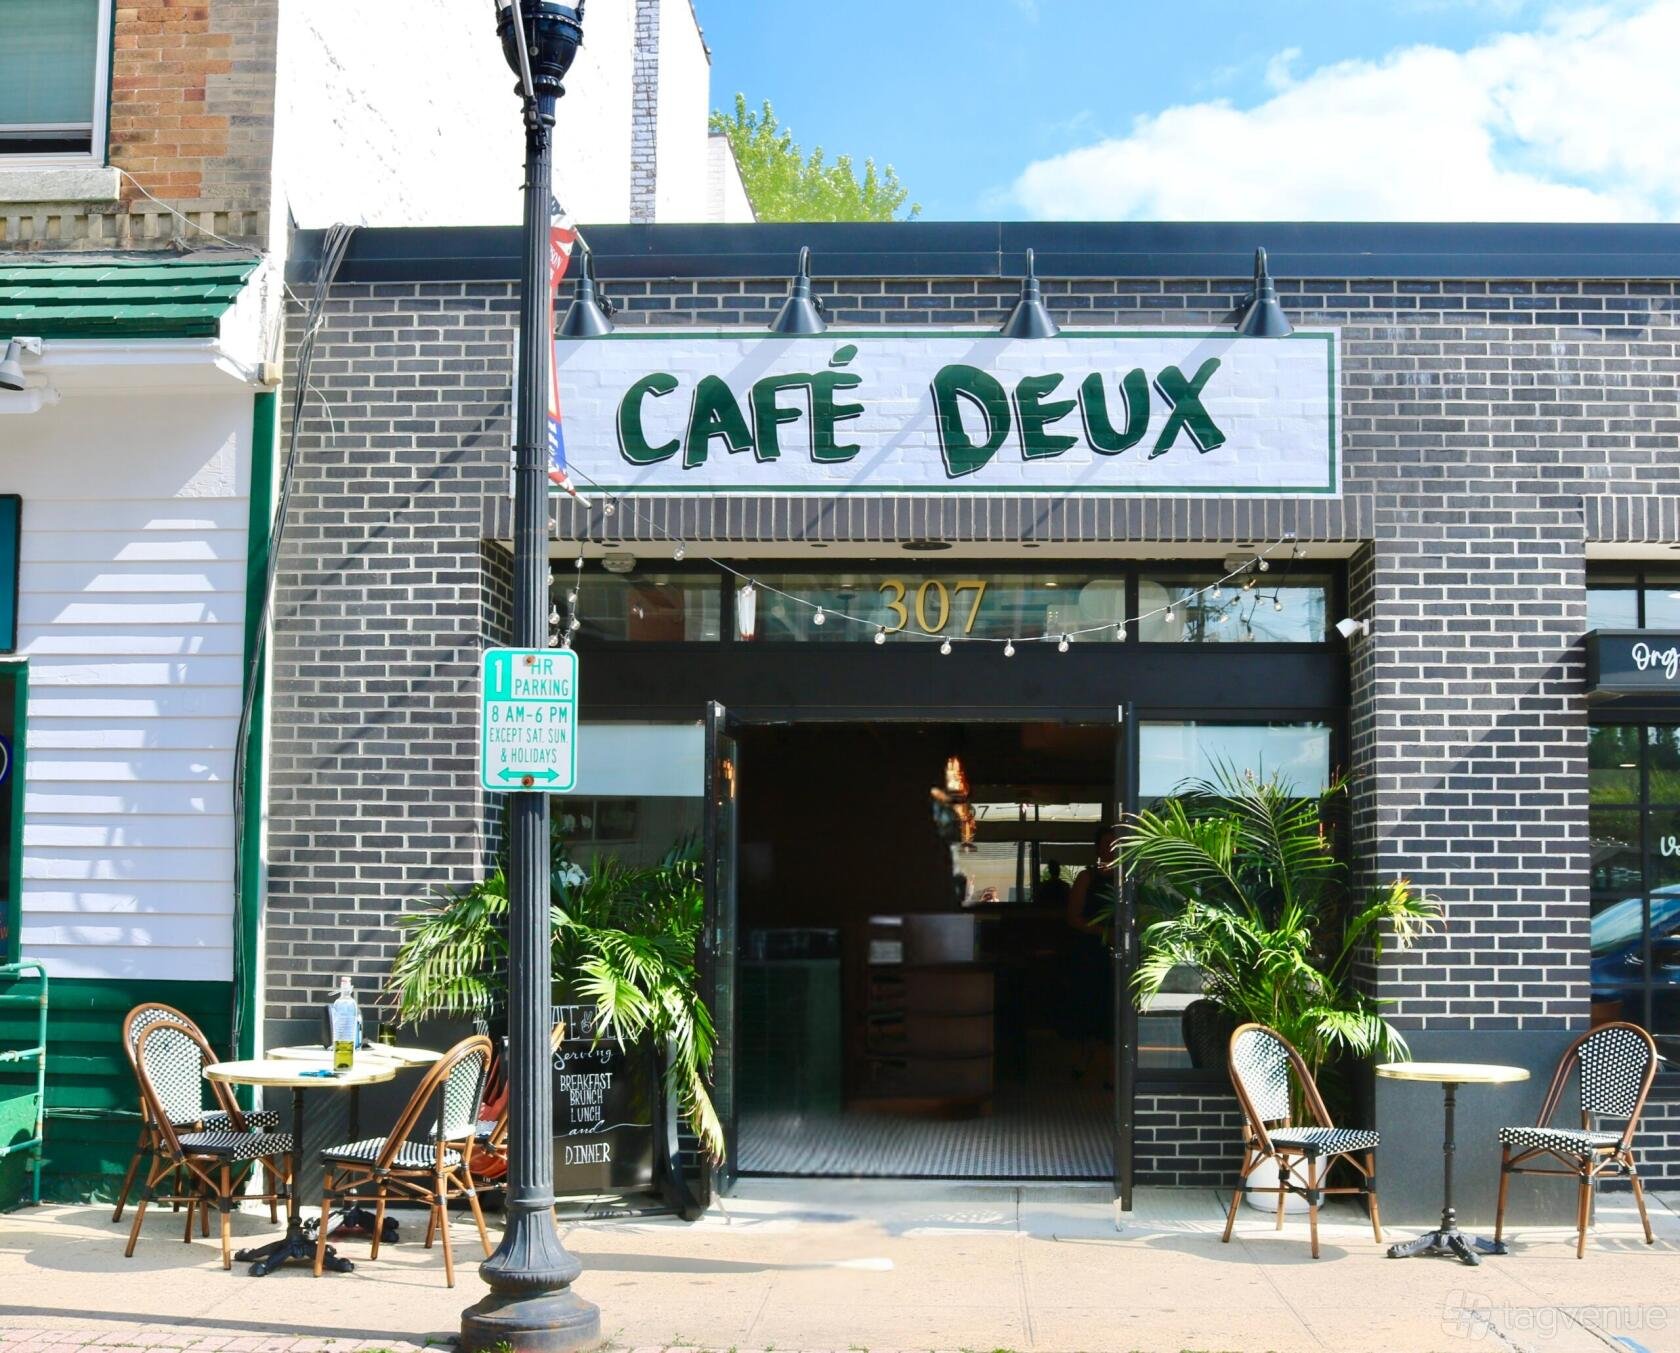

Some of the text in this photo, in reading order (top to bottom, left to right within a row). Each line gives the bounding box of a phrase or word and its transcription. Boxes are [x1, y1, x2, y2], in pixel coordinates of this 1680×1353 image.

[616, 344, 864, 471] CAFÉ
[929, 357, 1226, 479] DEUX
[879, 579, 988, 635] 307
[530, 659, 553, 676] HR
[1631, 642, 1680, 680] Org
[494, 659, 503, 693] 1
[515, 679, 569, 697] PARKING
[491, 705, 499, 723] 8
[550, 706, 568, 724] PM
[489, 728, 522, 743] EXCEPT
[500, 748, 558, 764] & HOLIDAYS
[560, 1072, 613, 1092] BREAKFAST
[569, 1089, 604, 1106] BRUNCH
[570, 1105, 601, 1123] LUNCH
[568, 1119, 606, 1136] and
[565, 1142, 612, 1165] DINNER
